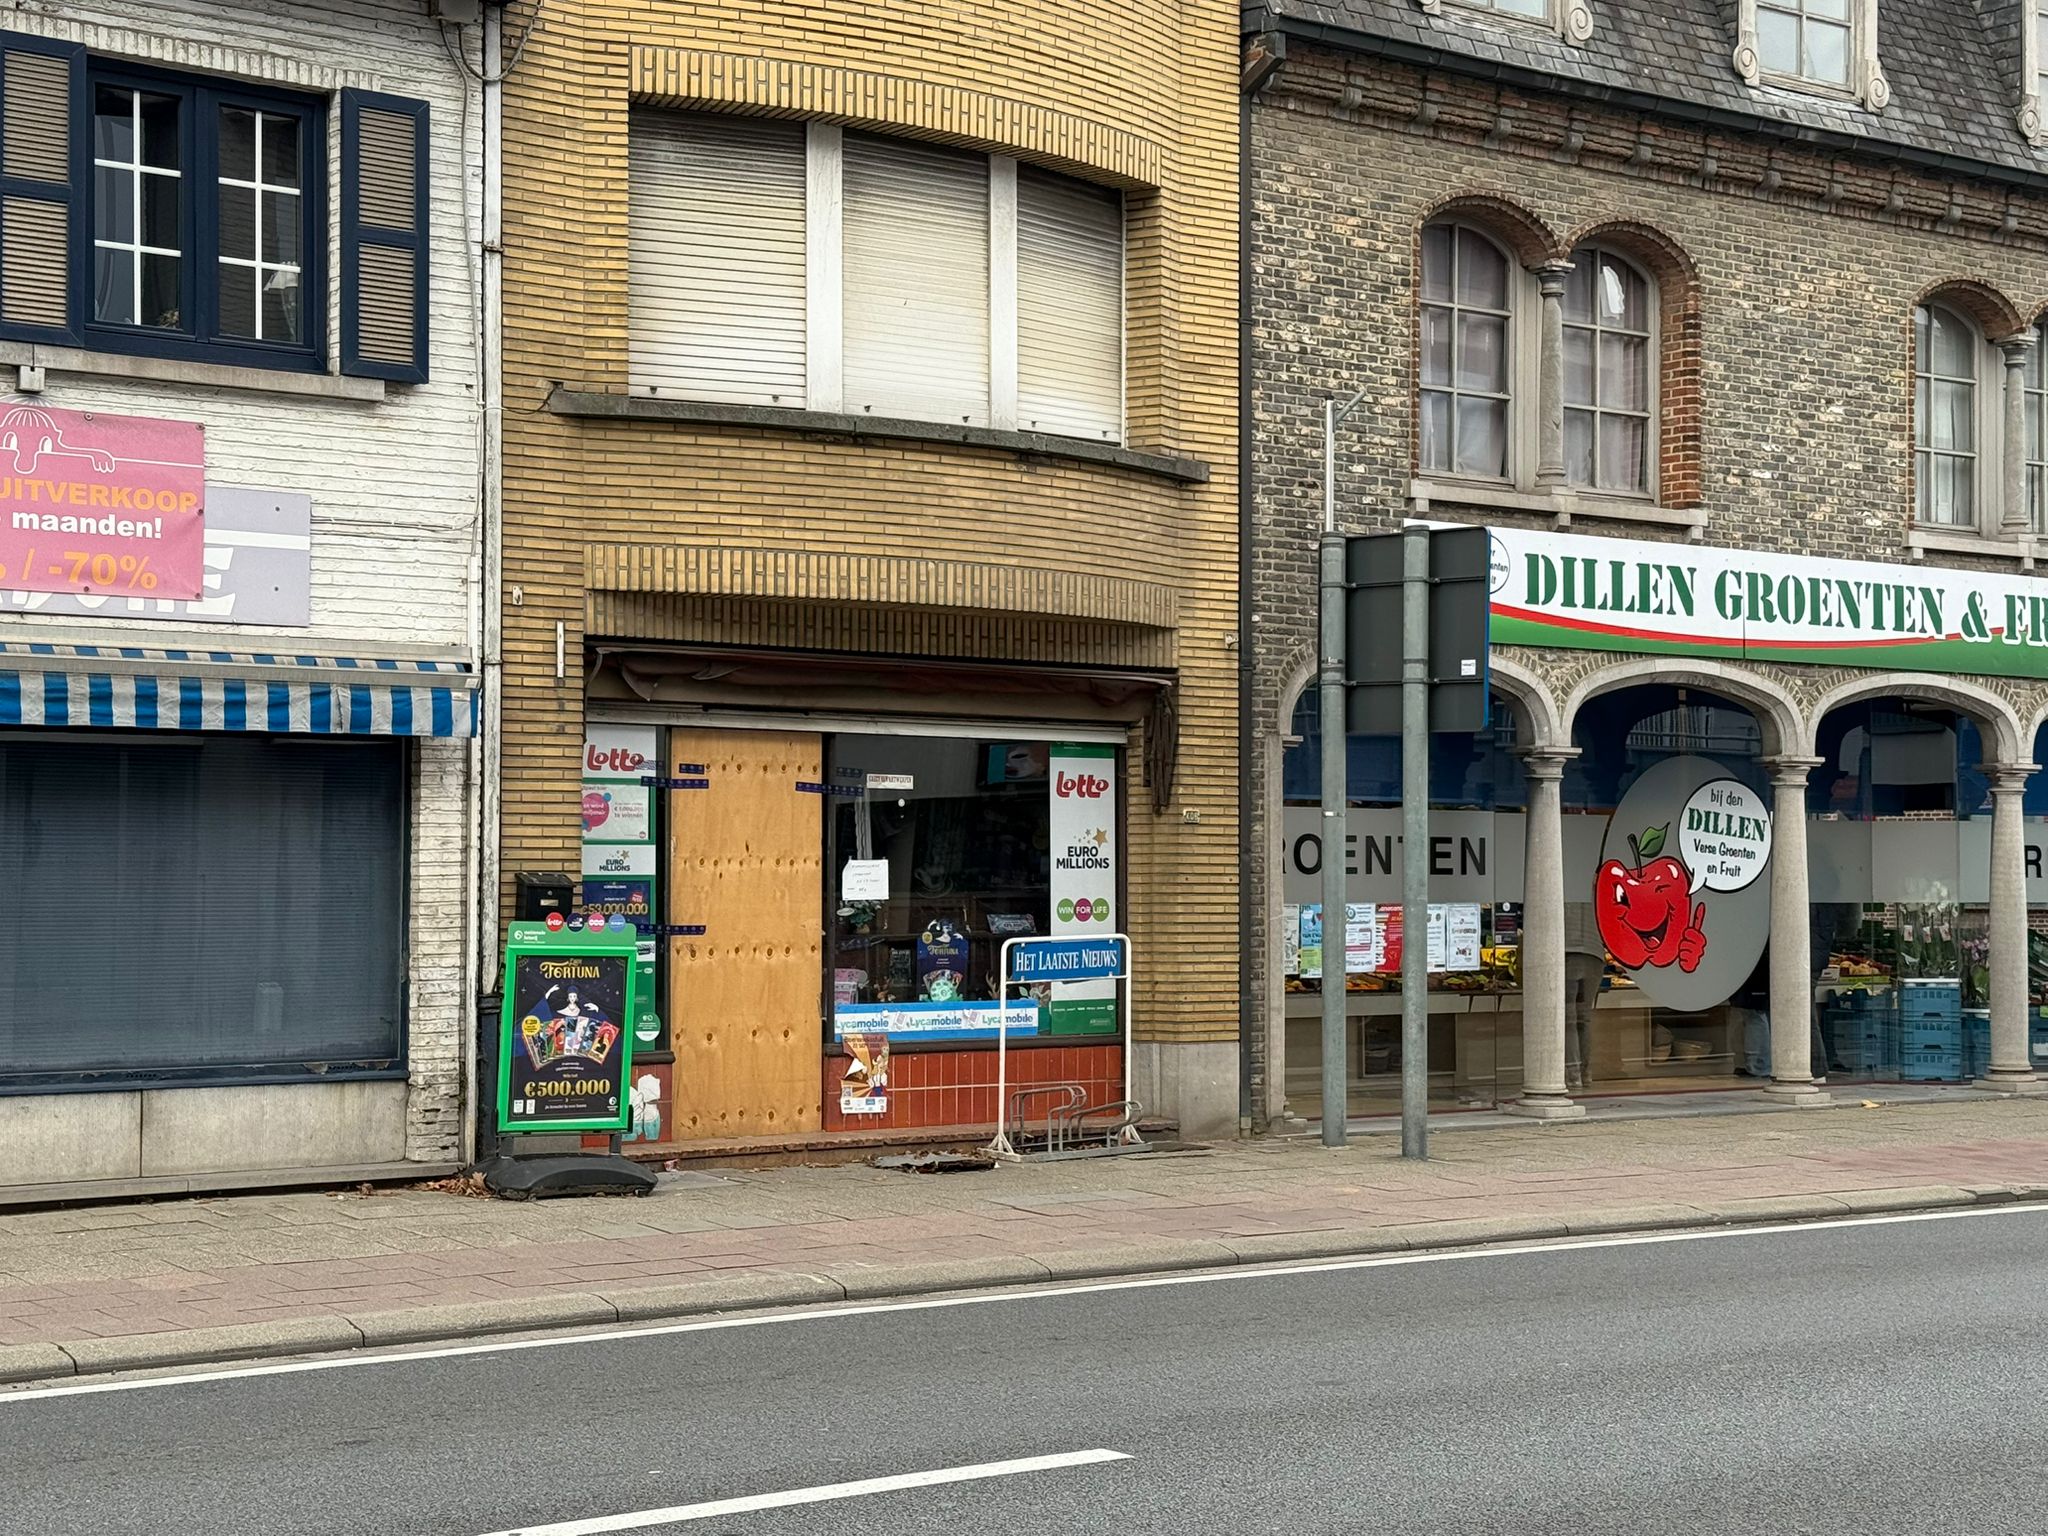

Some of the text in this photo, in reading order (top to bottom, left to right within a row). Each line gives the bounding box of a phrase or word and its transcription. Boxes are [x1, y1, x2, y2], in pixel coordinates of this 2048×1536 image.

[12, 511, 163, 539] maanden!
[49, 551, 158, 590] -70%
[1524, 553, 1697, 617] DILLEN
[1714, 569, 1945, 635] GROENTEN
[1961, 590, 1990, 638] &
[1710, 788, 1743, 807] bij den
[1687, 807, 1767, 842] DILLEN
[1067, 846, 1099, 857] EURO
[1693, 838, 1756, 860] Verse Groenten
[1056, 857, 1110, 869] MILLIONS
[1706, 860, 1741, 877] en Fruit
[1058, 906, 1108, 914] WIN FOR LIFE
[1016, 948, 1117, 972] HET LAATSTE NIEUWS
[835, 1018, 889, 1029] Lycamobile
[909, 1016, 962, 1027] Lycamobile
[524, 1079, 611, 1097] €500.000
